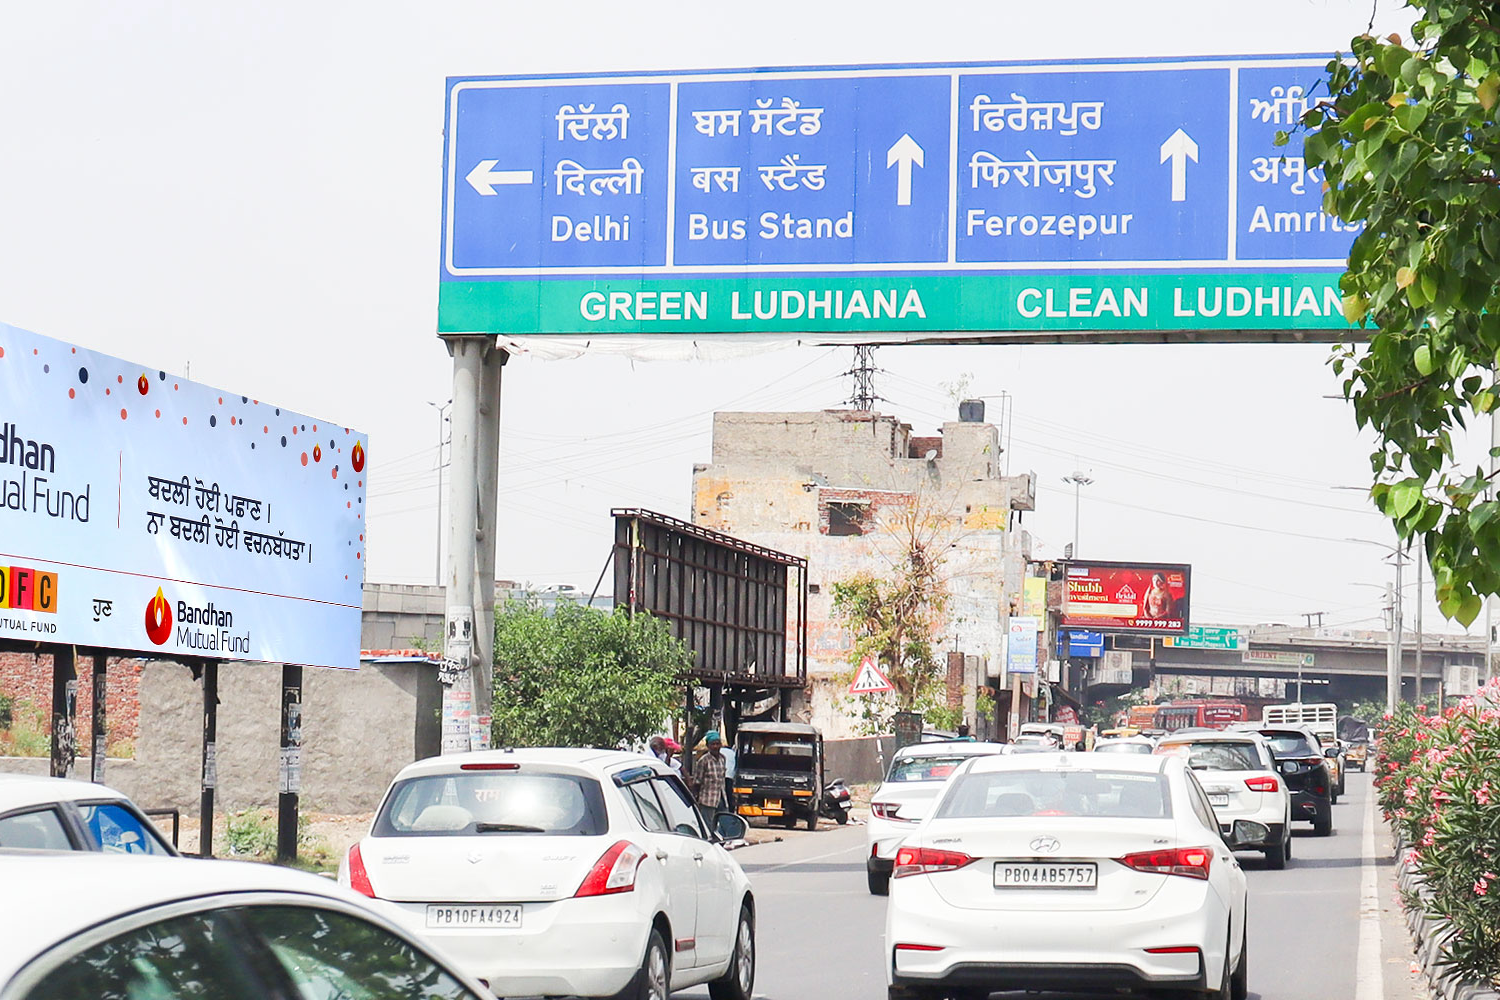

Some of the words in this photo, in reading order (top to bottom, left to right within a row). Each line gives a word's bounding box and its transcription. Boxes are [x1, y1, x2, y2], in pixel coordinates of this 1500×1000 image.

[555, 103, 630, 141] ਦਿੱਲੀ
[691, 110, 741, 137] ਬਸ
[969, 92, 1104, 136] ਫਿਰੋਜ਼ਪੁਰ
[554, 157, 644, 196] दिल्ली
[690, 167, 741, 193] बस
[757, 154, 827, 191] स्टैंड
[968, 150, 1116, 198] फिरोज़पुर
[551, 215, 630, 242] Delhi
[688, 213, 746, 241] Bus
[759, 211, 853, 240] Stand
[967, 209, 1133, 240] Ferozepur
[580, 291, 708, 321] GREEN
[731, 289, 926, 320] LUDHIANA
[1016, 287, 1148, 318] CLEAN
[1173, 286, 1345, 317] LUDHIAN
[33, 476, 90, 523] Fund
[148, 475, 191, 506] ਬਦਲੀ
[195, 477, 220, 512] ਹੋਈ
[147, 511, 165, 535] ਨਾ
[170, 514, 211, 545] ਬਦਲੀ
[214, 516, 240, 550] ਹੋਈ
[1068, 581, 1103, 593] Shubh
[1068, 593, 1109, 602] nvestment
[92, 598, 113, 622] ਹੁਣ
[177, 600, 233, 628] Bandhan
[30, 621, 57, 634] FUND
[176, 626, 219, 651] Mutual
[221, 630, 250, 654] Fund
[1003, 867, 1094, 884] PB04AB5757
[436, 909, 520, 924] PB10FA4924
